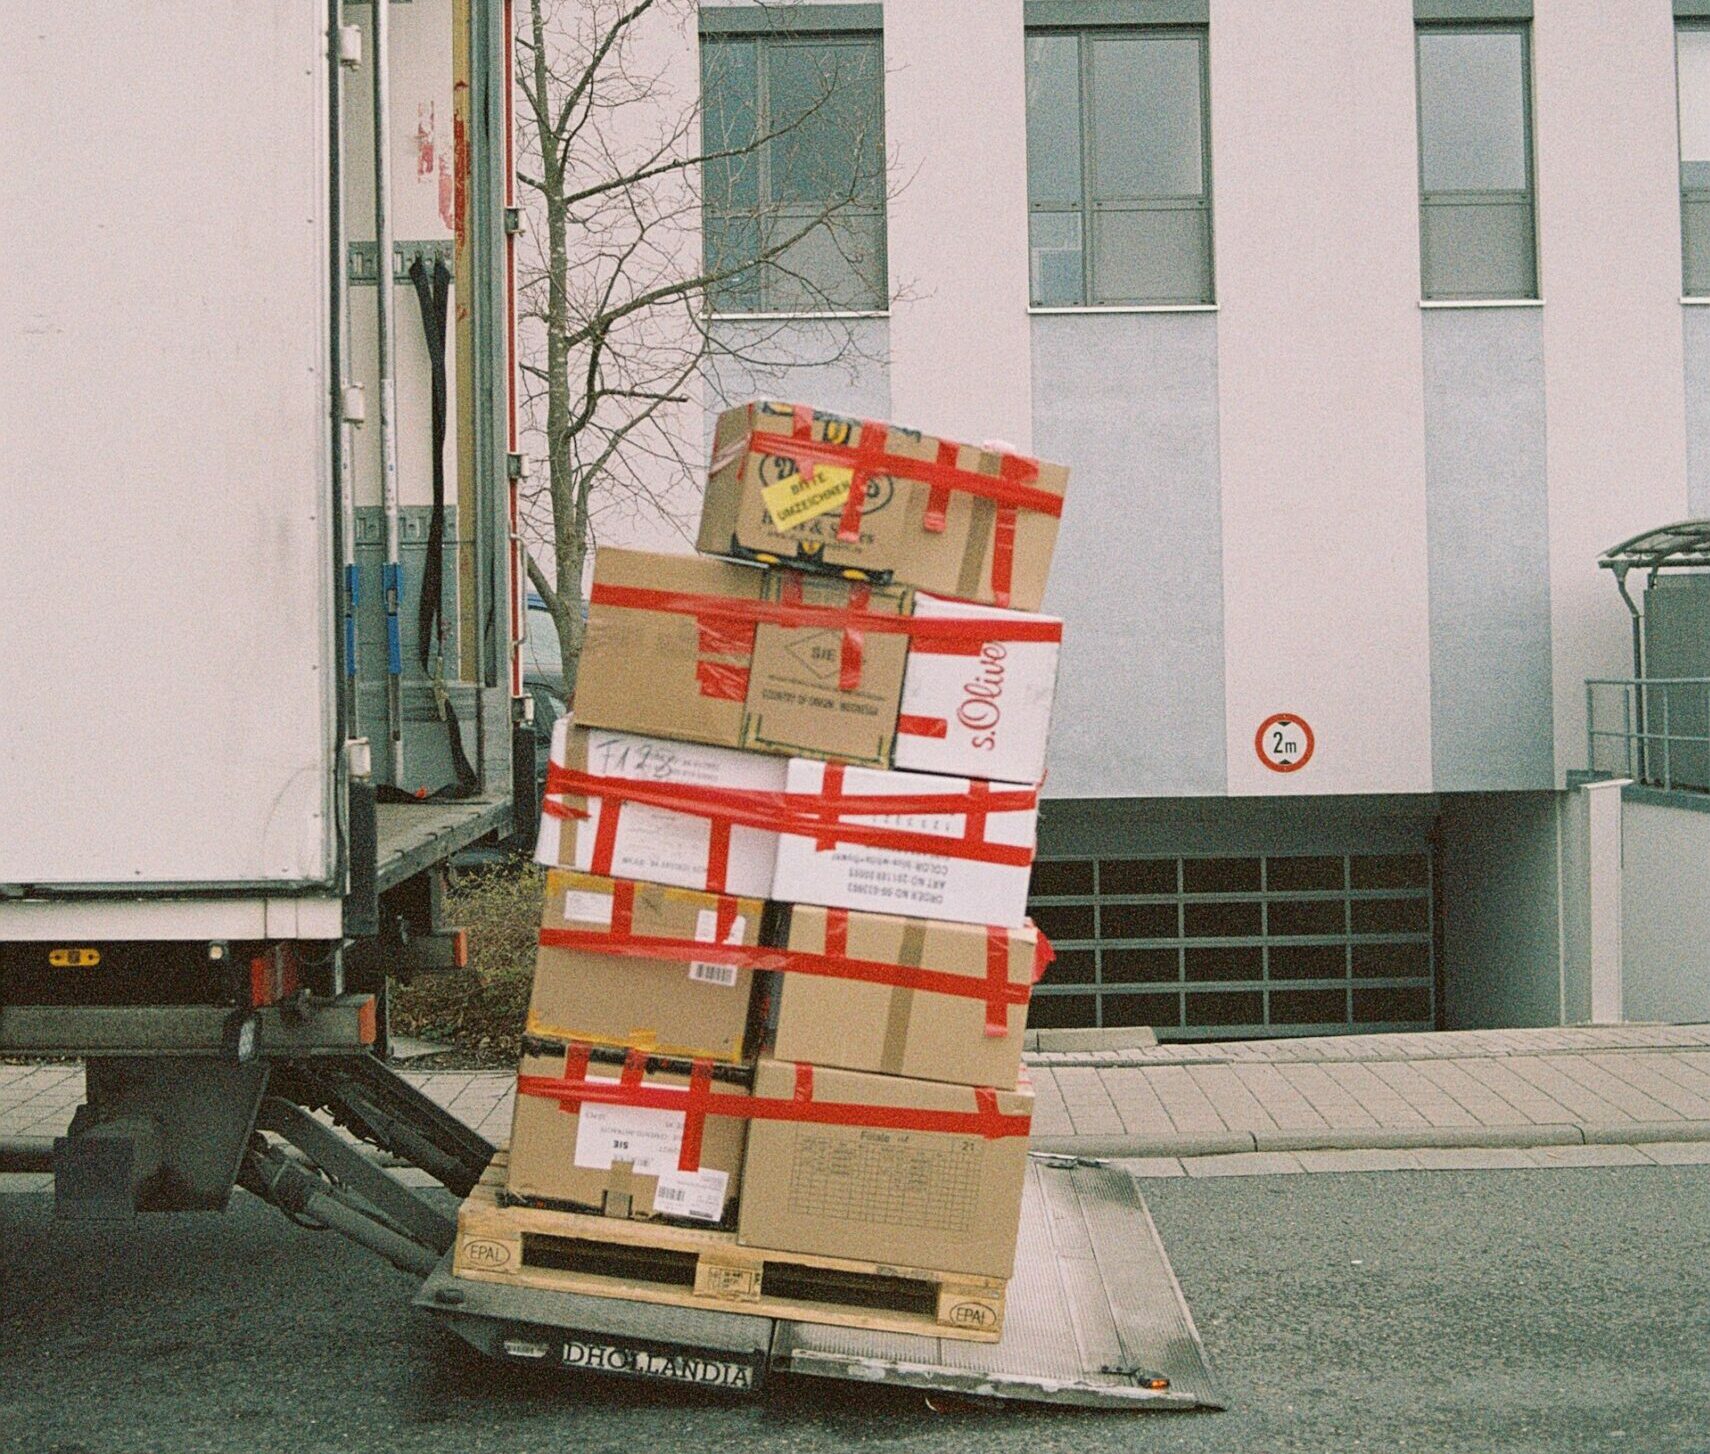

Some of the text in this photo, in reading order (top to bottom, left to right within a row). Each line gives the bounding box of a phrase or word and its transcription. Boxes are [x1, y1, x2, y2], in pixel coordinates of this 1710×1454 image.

[957, 641, 1007, 751] s.Olive
[1273, 731, 1297, 753] 2m
[470, 1244, 502, 1263] EPAL
[564, 1342, 750, 1388] DHOLLANDIA
